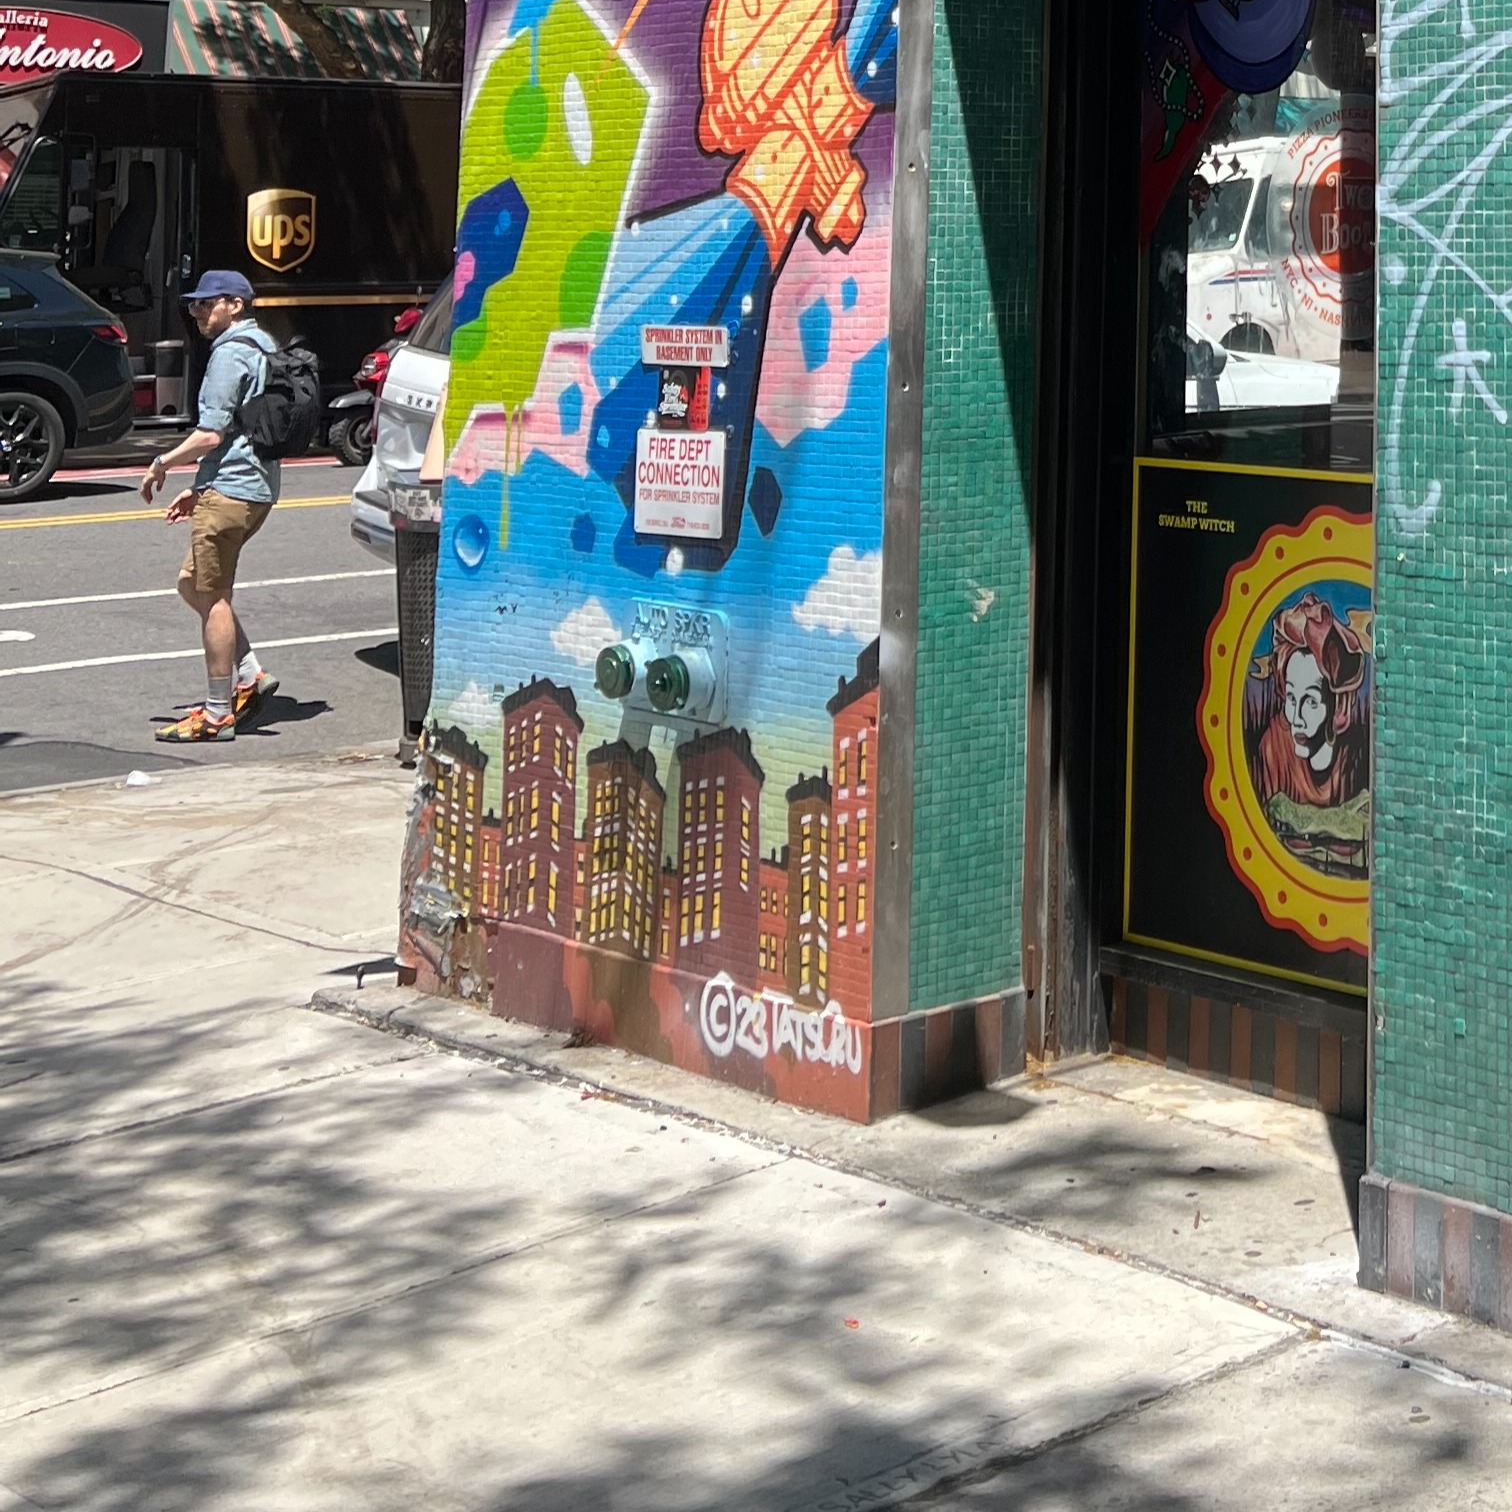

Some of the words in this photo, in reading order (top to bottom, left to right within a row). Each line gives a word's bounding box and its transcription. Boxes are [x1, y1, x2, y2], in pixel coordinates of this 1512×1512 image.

[0, 28, 116, 70] ntonio
[1287, 126, 1314, 160] PIZZA
[252, 214, 311, 260] ups
[1281, 258, 1298, 289] NYC
[1301, 292, 1313, 311] NJ
[645, 328, 683, 344] SPRINKLER
[685, 328, 714, 345] SYSTEM
[715, 329, 723, 345] IN
[656, 345, 694, 362] BASEMENT
[696, 346, 713, 362] ONLY
[649, 437, 676, 461] FIRE
[678, 438, 712, 462] DEPT
[638, 461, 720, 488] CONNECTION
[639, 488, 653, 502] FOR
[653, 489, 691, 504] SPRINKLER
[692, 491, 720, 506] SYSTEM
[1185, 500, 1208, 514] THE
[1158, 514, 1198, 529] SWAMP
[1198, 518, 1236, 534] WITCH
